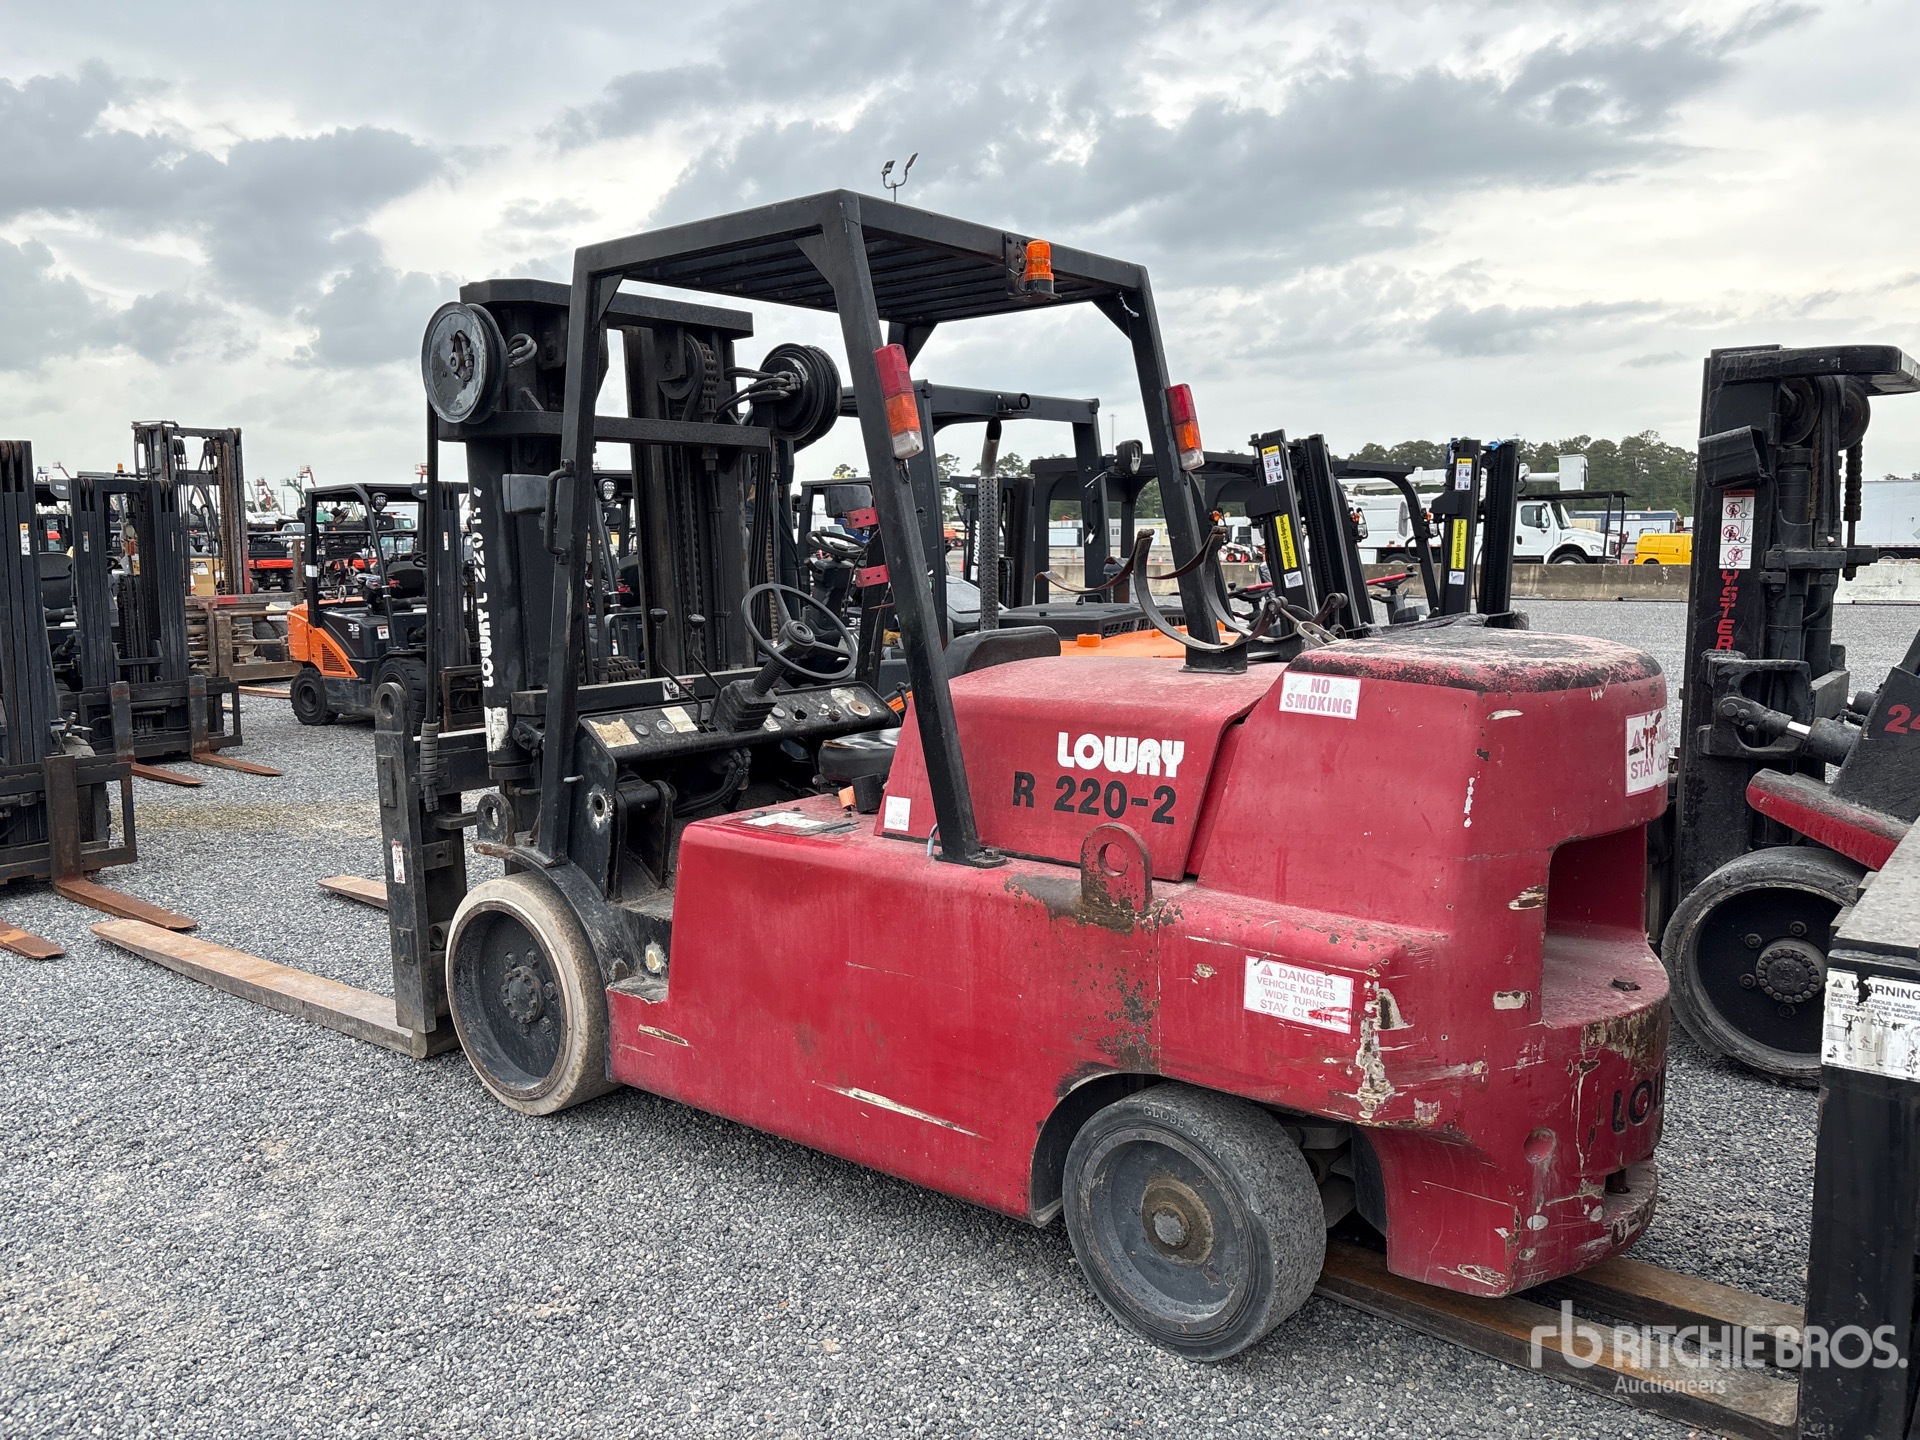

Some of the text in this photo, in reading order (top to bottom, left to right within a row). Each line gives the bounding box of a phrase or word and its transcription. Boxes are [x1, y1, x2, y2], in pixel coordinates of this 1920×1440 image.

[973, 520, 981, 565] DOOSAN
[1715, 569, 1740, 651] YSTER
[347, 623, 360, 632] 35
[476, 609, 494, 688] LOWRY
[1310, 678, 1331, 695] NO
[1285, 692, 1353, 715] SMOKING
[1057, 731, 1185, 778] LOWRY
[1631, 757, 1655, 780] STAY
[1012, 771, 1177, 825] R 220-2
[1256, 975, 1336, 1001] VEHICLE MAKES
[1279, 967, 1334, 990] DANGER
[1260, 998, 1289, 1014] STAY
[1264, 988, 1326, 1010] WIDE TURNS
[1871, 1003, 1889, 1011] FROM
[1891, 1007, 1920, 1016] IMPROPE
[1842, 1013, 1866, 1024] STAY
[1143, 1105, 1185, 1129] GLOBE
